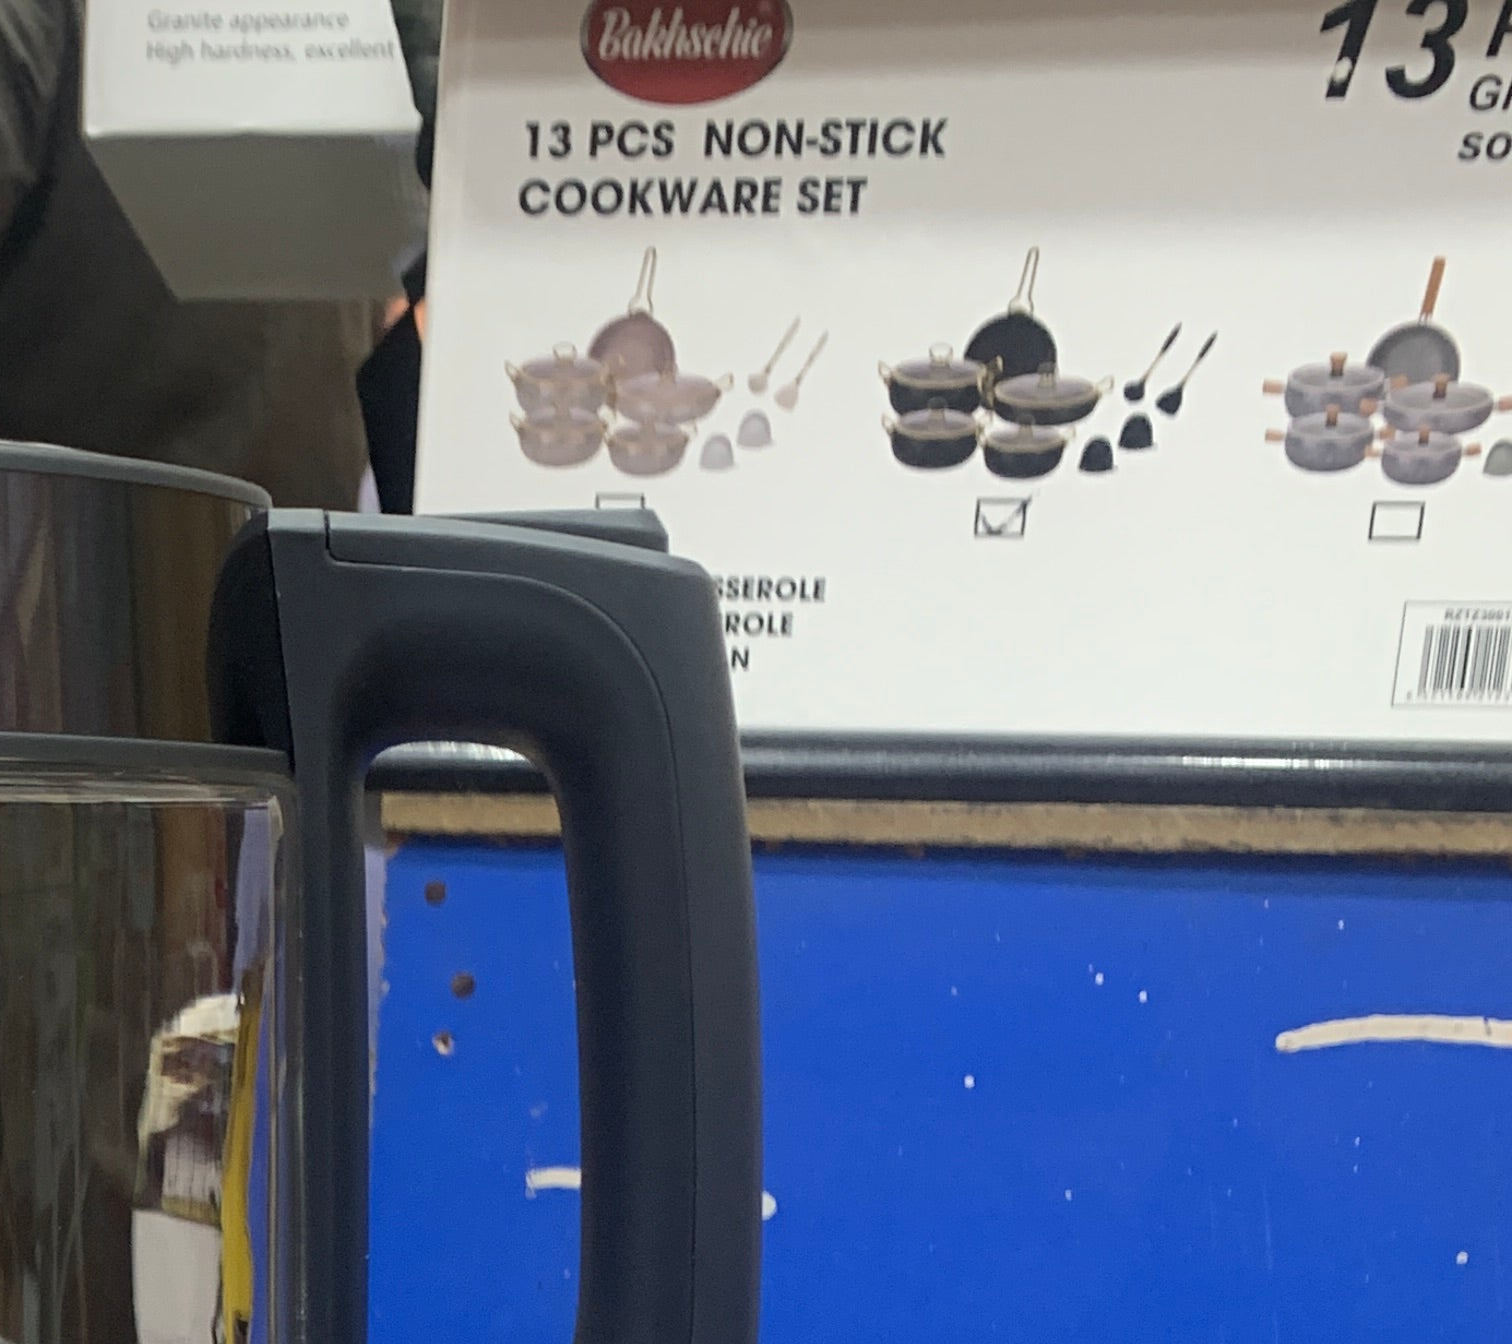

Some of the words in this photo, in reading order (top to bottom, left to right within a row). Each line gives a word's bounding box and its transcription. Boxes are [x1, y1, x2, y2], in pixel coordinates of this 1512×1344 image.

[147, 9, 224, 31] Granite
[229, 11, 350, 34] appearance
[145, 39, 195, 69] High
[304, 38, 395, 62] excellent
[1319, 0, 1469, 99] 13
[524, 119, 573, 158] 13
[588, 118, 676, 158] PCS
[702, 116, 948, 159] NON-STICK
[518, 176, 782, 218] COOKWARE
[795, 175, 869, 217] SET
[715, 574, 826, 602] SSEROLE
[725, 610, 794, 638] ROLE
